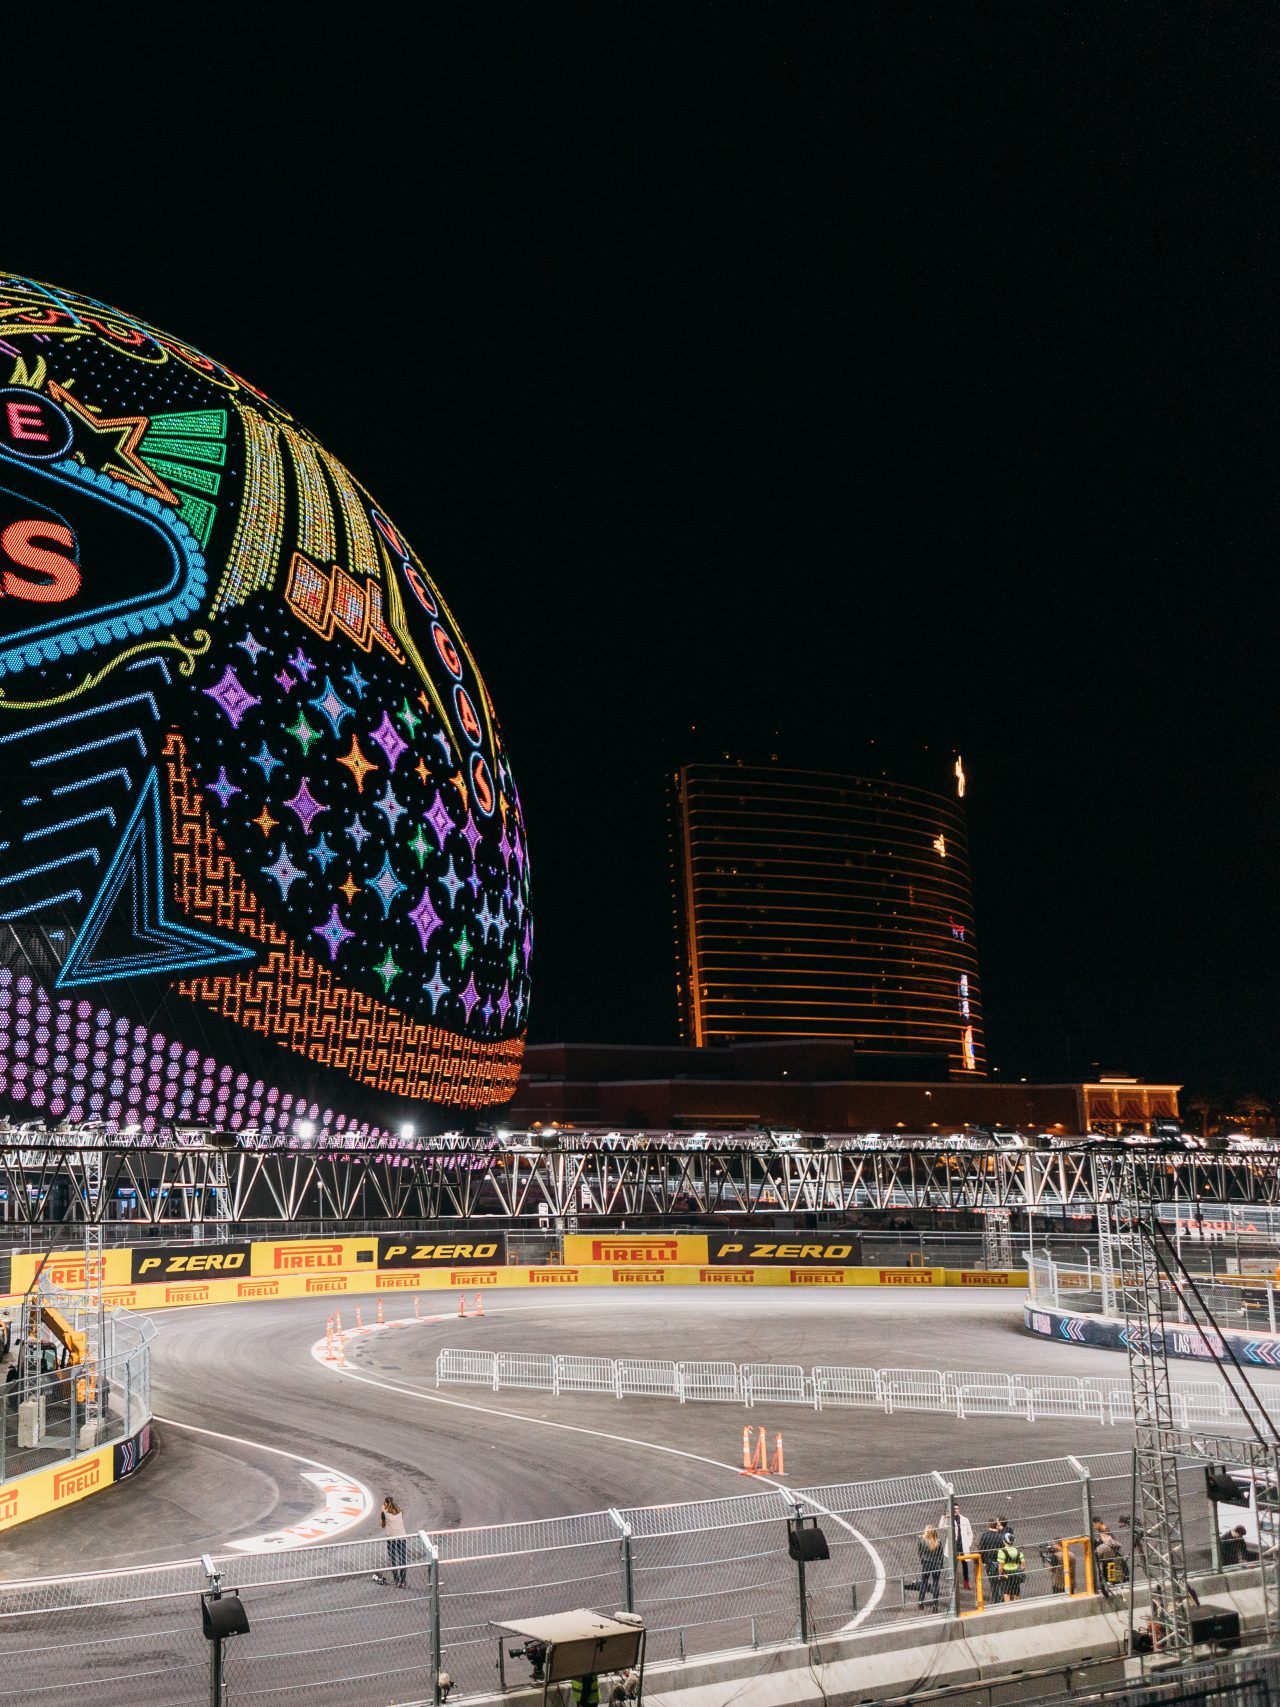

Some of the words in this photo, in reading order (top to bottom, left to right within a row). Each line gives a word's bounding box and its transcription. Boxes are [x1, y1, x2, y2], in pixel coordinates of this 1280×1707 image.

[273, 1244, 344, 1270] PIRELLI
[384, 1246, 407, 1261] P
[411, 1243, 498, 1260] ZERO
[592, 1240, 678, 1261] PIRELLI
[717, 1243, 744, 1258] P
[748, 1244, 853, 1259] ZERO
[138, 1256, 164, 1275] P
[165, 1252, 247, 1274] ZERO
[376, 1273, 420, 1288] PIRELLI
[450, 1270, 497, 1286] PIRELLI
[529, 1269, 579, 1283] PIRELLI
[612, 1269, 665, 1283] PIRELLI
[699, 1269, 754, 1283] PIRELLI
[789, 1269, 845, 1284] PIRELLI
[879, 1270, 933, 1284] PIRELLI
[961, 1272, 1009, 1285] PIRELLI
[237, 1280, 279, 1297] PIRELLI
[305, 1276, 348, 1293] PIRELLI
[165, 1285, 209, 1304] PIRELLI
[1173, 1333, 1190, 1354] LAS
[54, 1458, 100, 1501] PIRELLI
